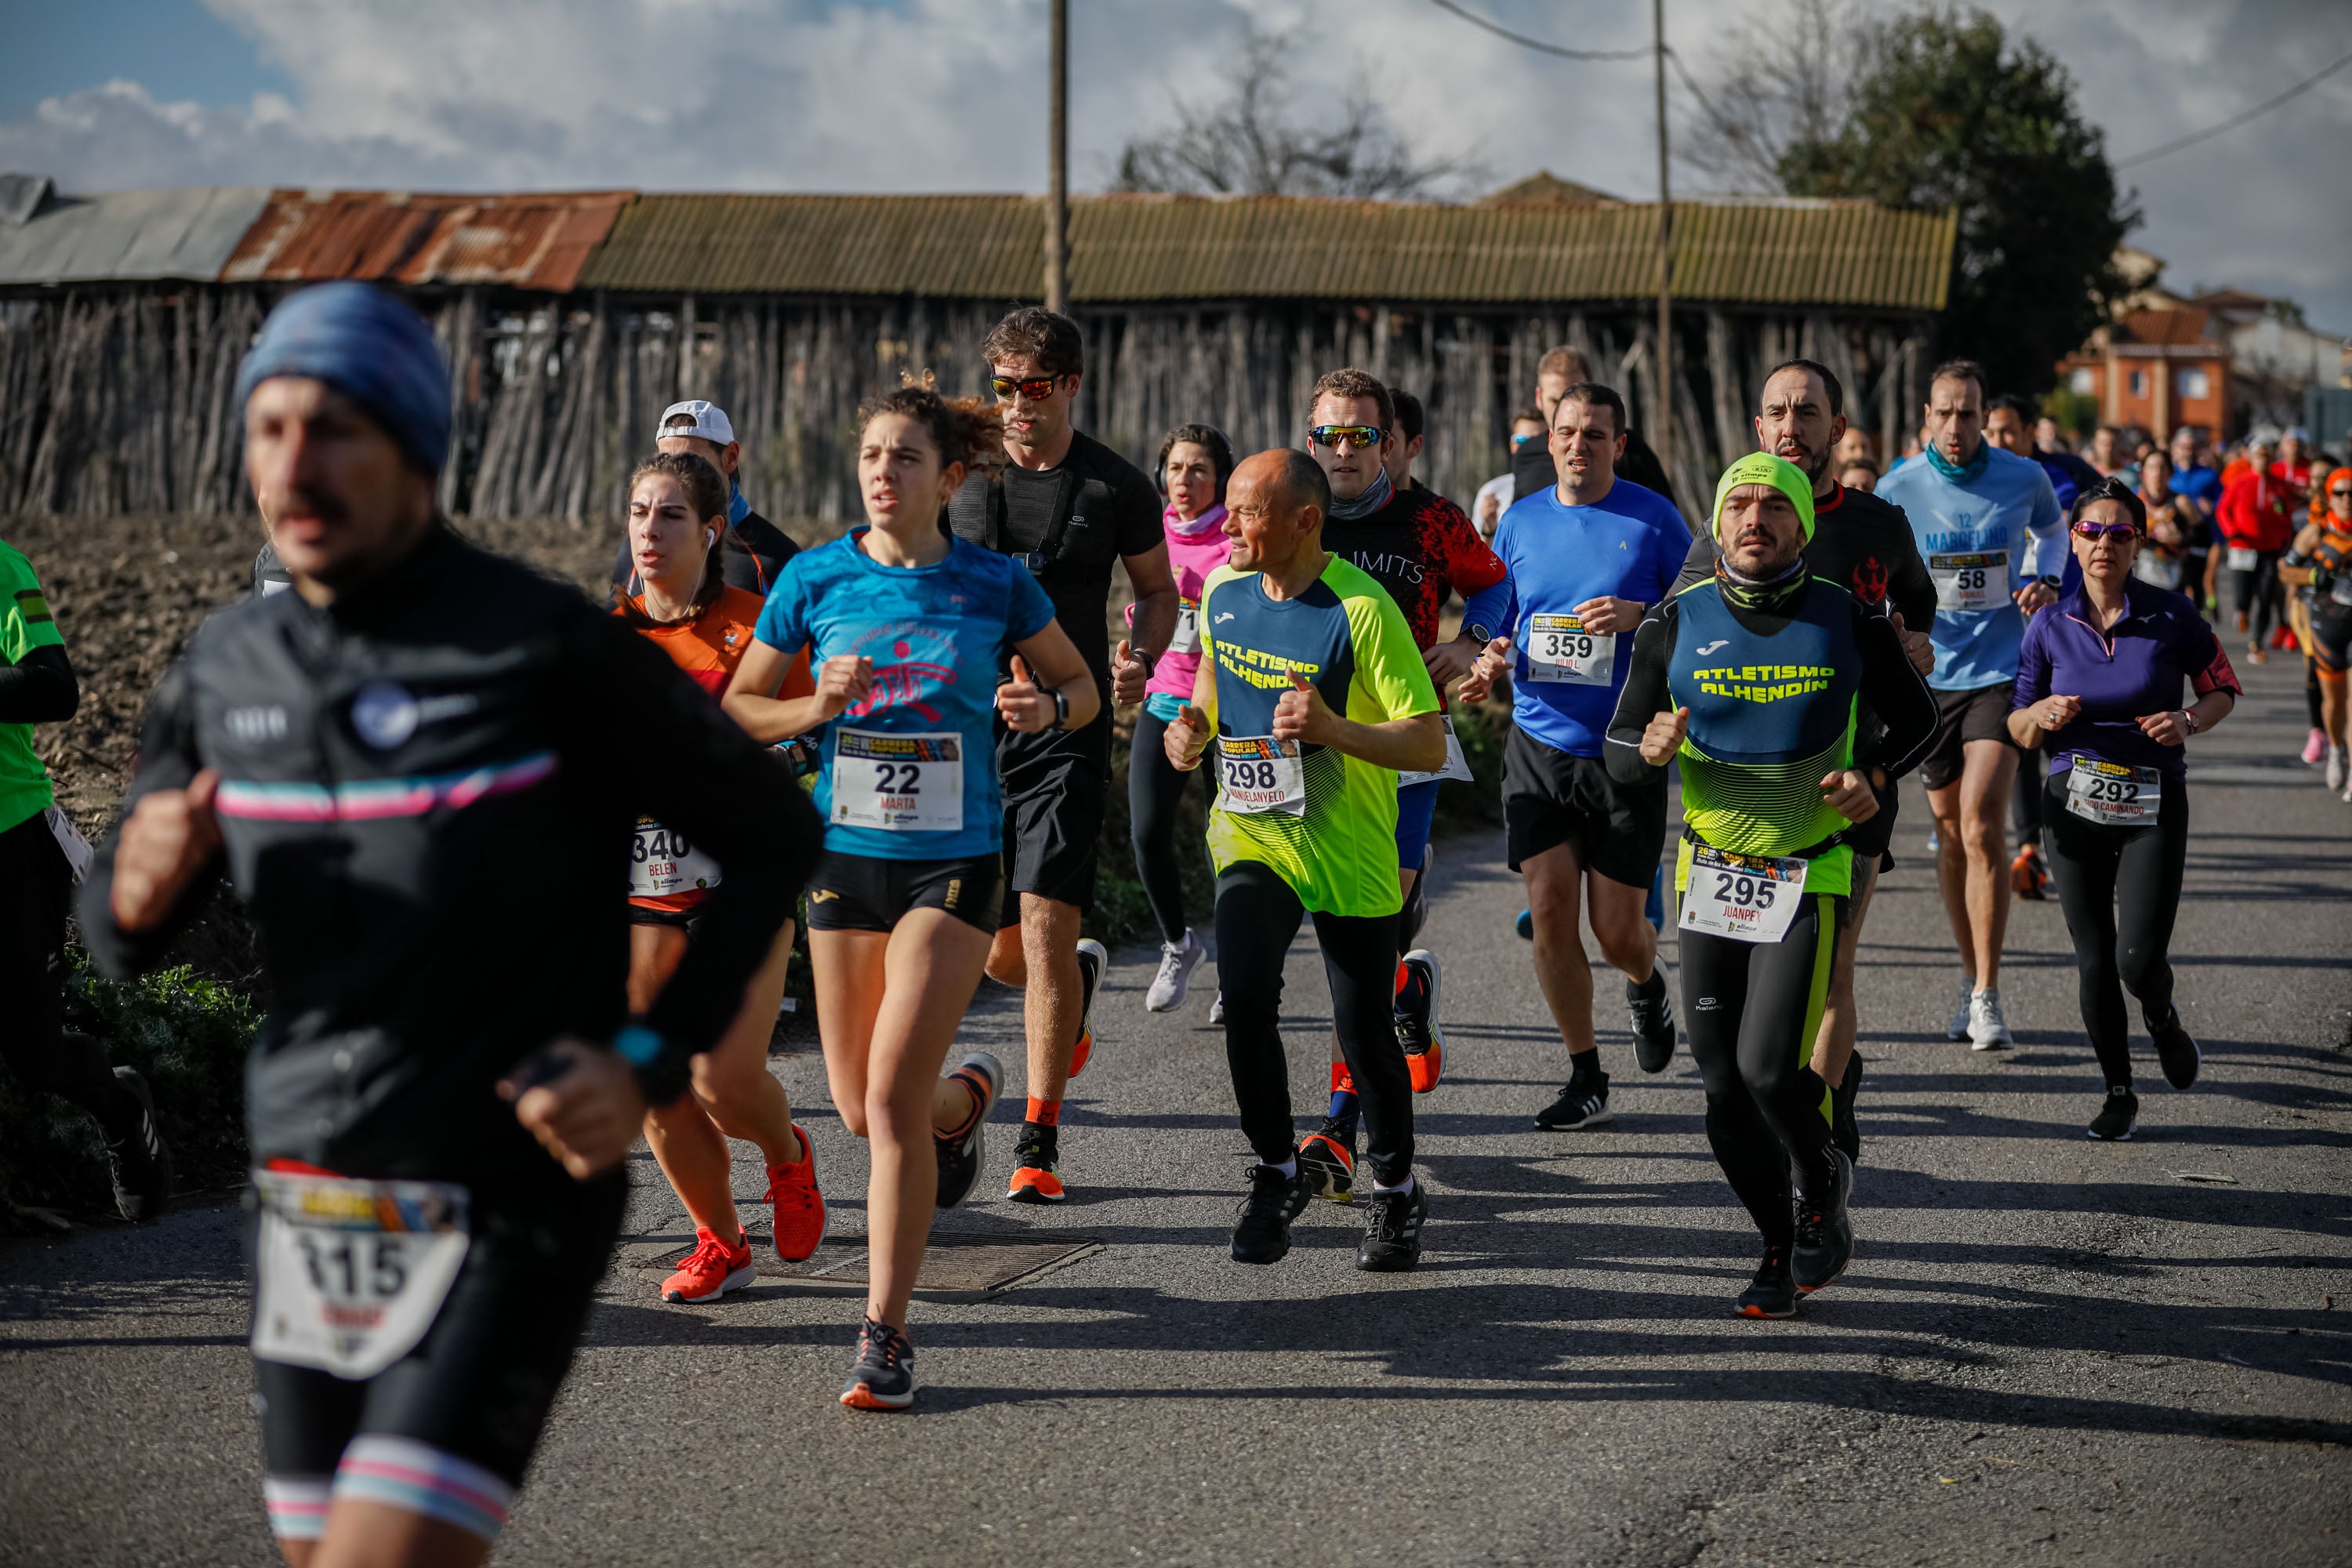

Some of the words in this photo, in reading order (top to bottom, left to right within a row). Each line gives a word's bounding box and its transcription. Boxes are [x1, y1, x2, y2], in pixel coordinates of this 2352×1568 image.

[1958, 513, 1972, 528] 12
[1926, 526, 2008, 550] MARCELINO
[1336, 550, 1425, 583] IMITS
[1958, 570, 1986, 590] 58
[1215, 640, 1319, 673] ATLETISMO
[1545, 634, 1593, 659] 359
[1219, 653, 1311, 690] ALHEND
[1555, 659, 1573, 669] JULIO
[1693, 666, 1835, 681] ATLETISMO
[1700, 679, 1828, 704] ALHENDÍN
[869, 738, 916, 746] CARRERA
[869, 744, 916, 753] POPULAR
[874, 763, 920, 794] 22
[1225, 761, 1276, 789] 298
[2089, 778, 2139, 804] 292
[880, 796, 916, 811] MARTA
[2100, 802, 2144, 815] CAMINANDO
[633, 831, 691, 863] 340
[1697, 846, 1708, 855] 26
[648, 862, 677, 877] BELEN
[1714, 873, 1777, 909] 295
